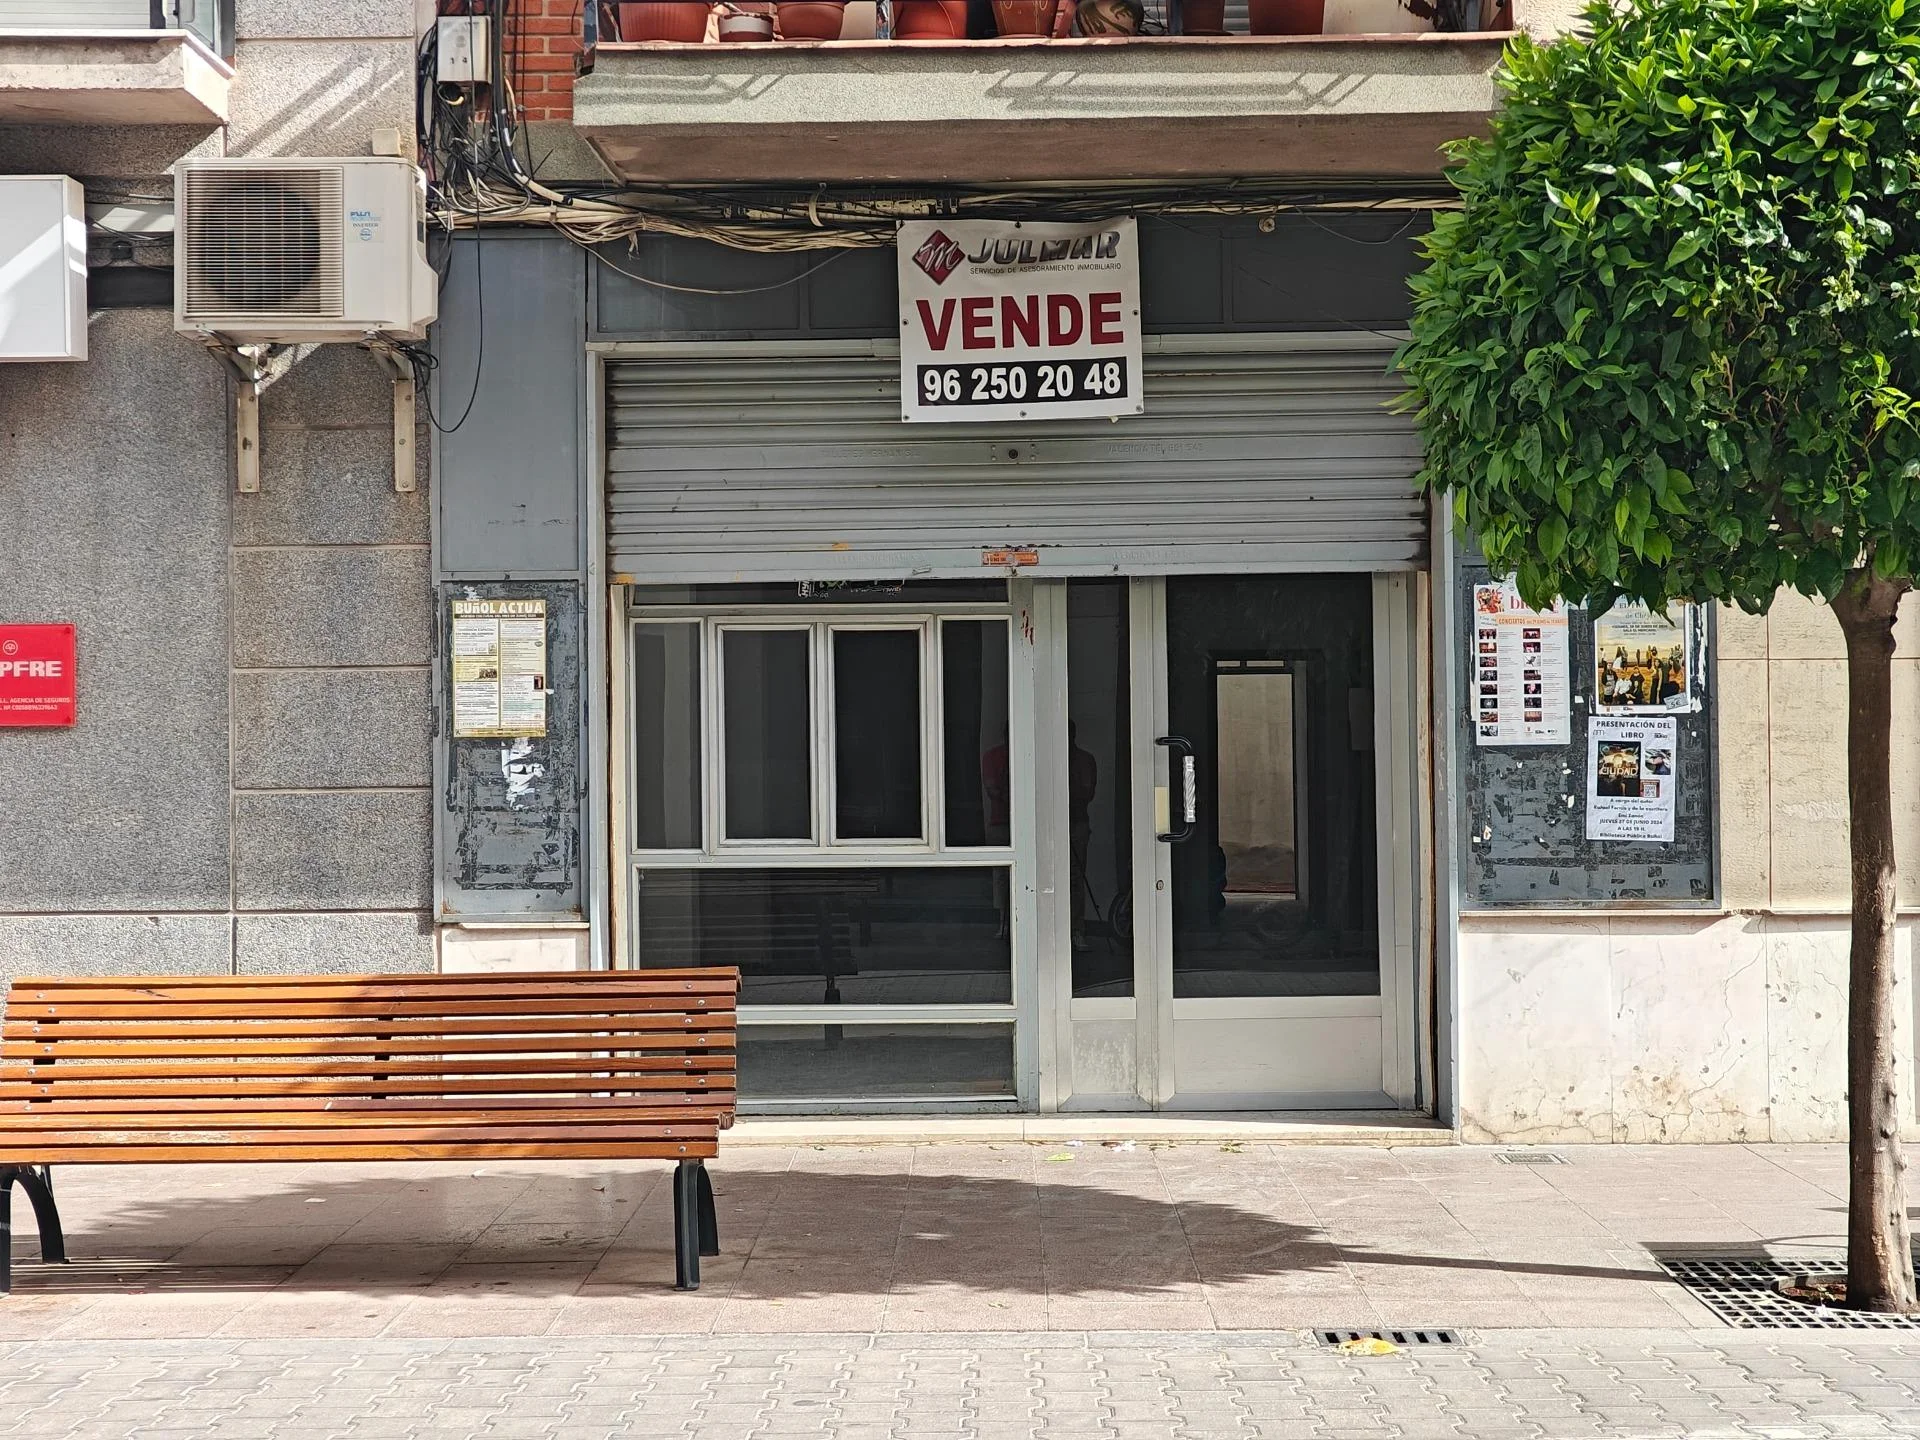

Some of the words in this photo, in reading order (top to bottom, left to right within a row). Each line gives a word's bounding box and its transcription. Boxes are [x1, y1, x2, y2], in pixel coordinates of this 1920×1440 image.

[967, 231, 1121, 265] JULMAR
[970, 266, 1005, 275] SERVICIOS
[1019, 264, 1075, 273] ASESORAMIENTO
[1077, 262, 1122, 270] INMOBILIARIO
[915, 292, 1124, 351] VENDE
[923, 369, 962, 402] 96
[971, 366, 1027, 400] 250
[1037, 364, 1075, 397] 20
[1083, 362, 1121, 394] 48
[500, 602, 543, 614] ACTUA
[1596, 720, 1655, 729] PRESENTACIÓN
